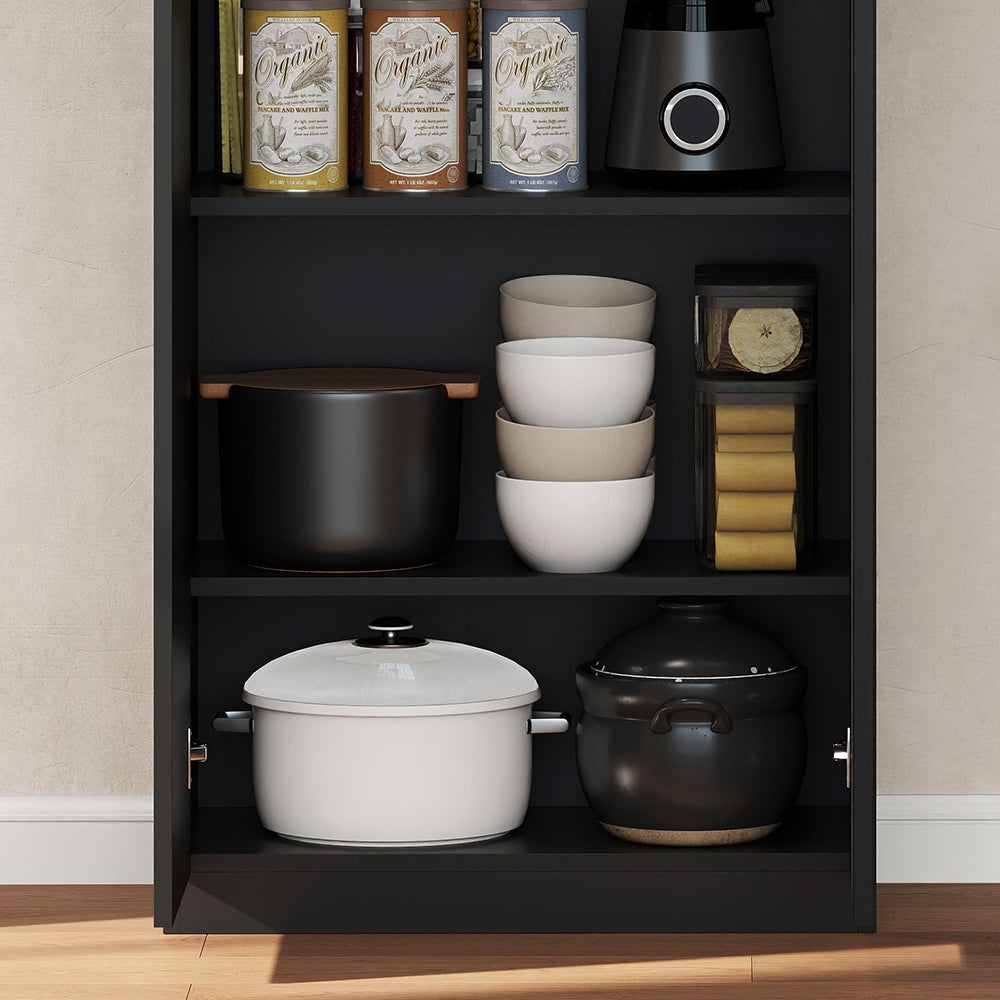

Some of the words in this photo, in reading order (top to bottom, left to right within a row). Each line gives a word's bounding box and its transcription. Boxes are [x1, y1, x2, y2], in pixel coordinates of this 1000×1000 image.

[255, 35, 328, 89] Organic
[375, 35, 448, 89] Organic
[495, 35, 568, 89] Organic
